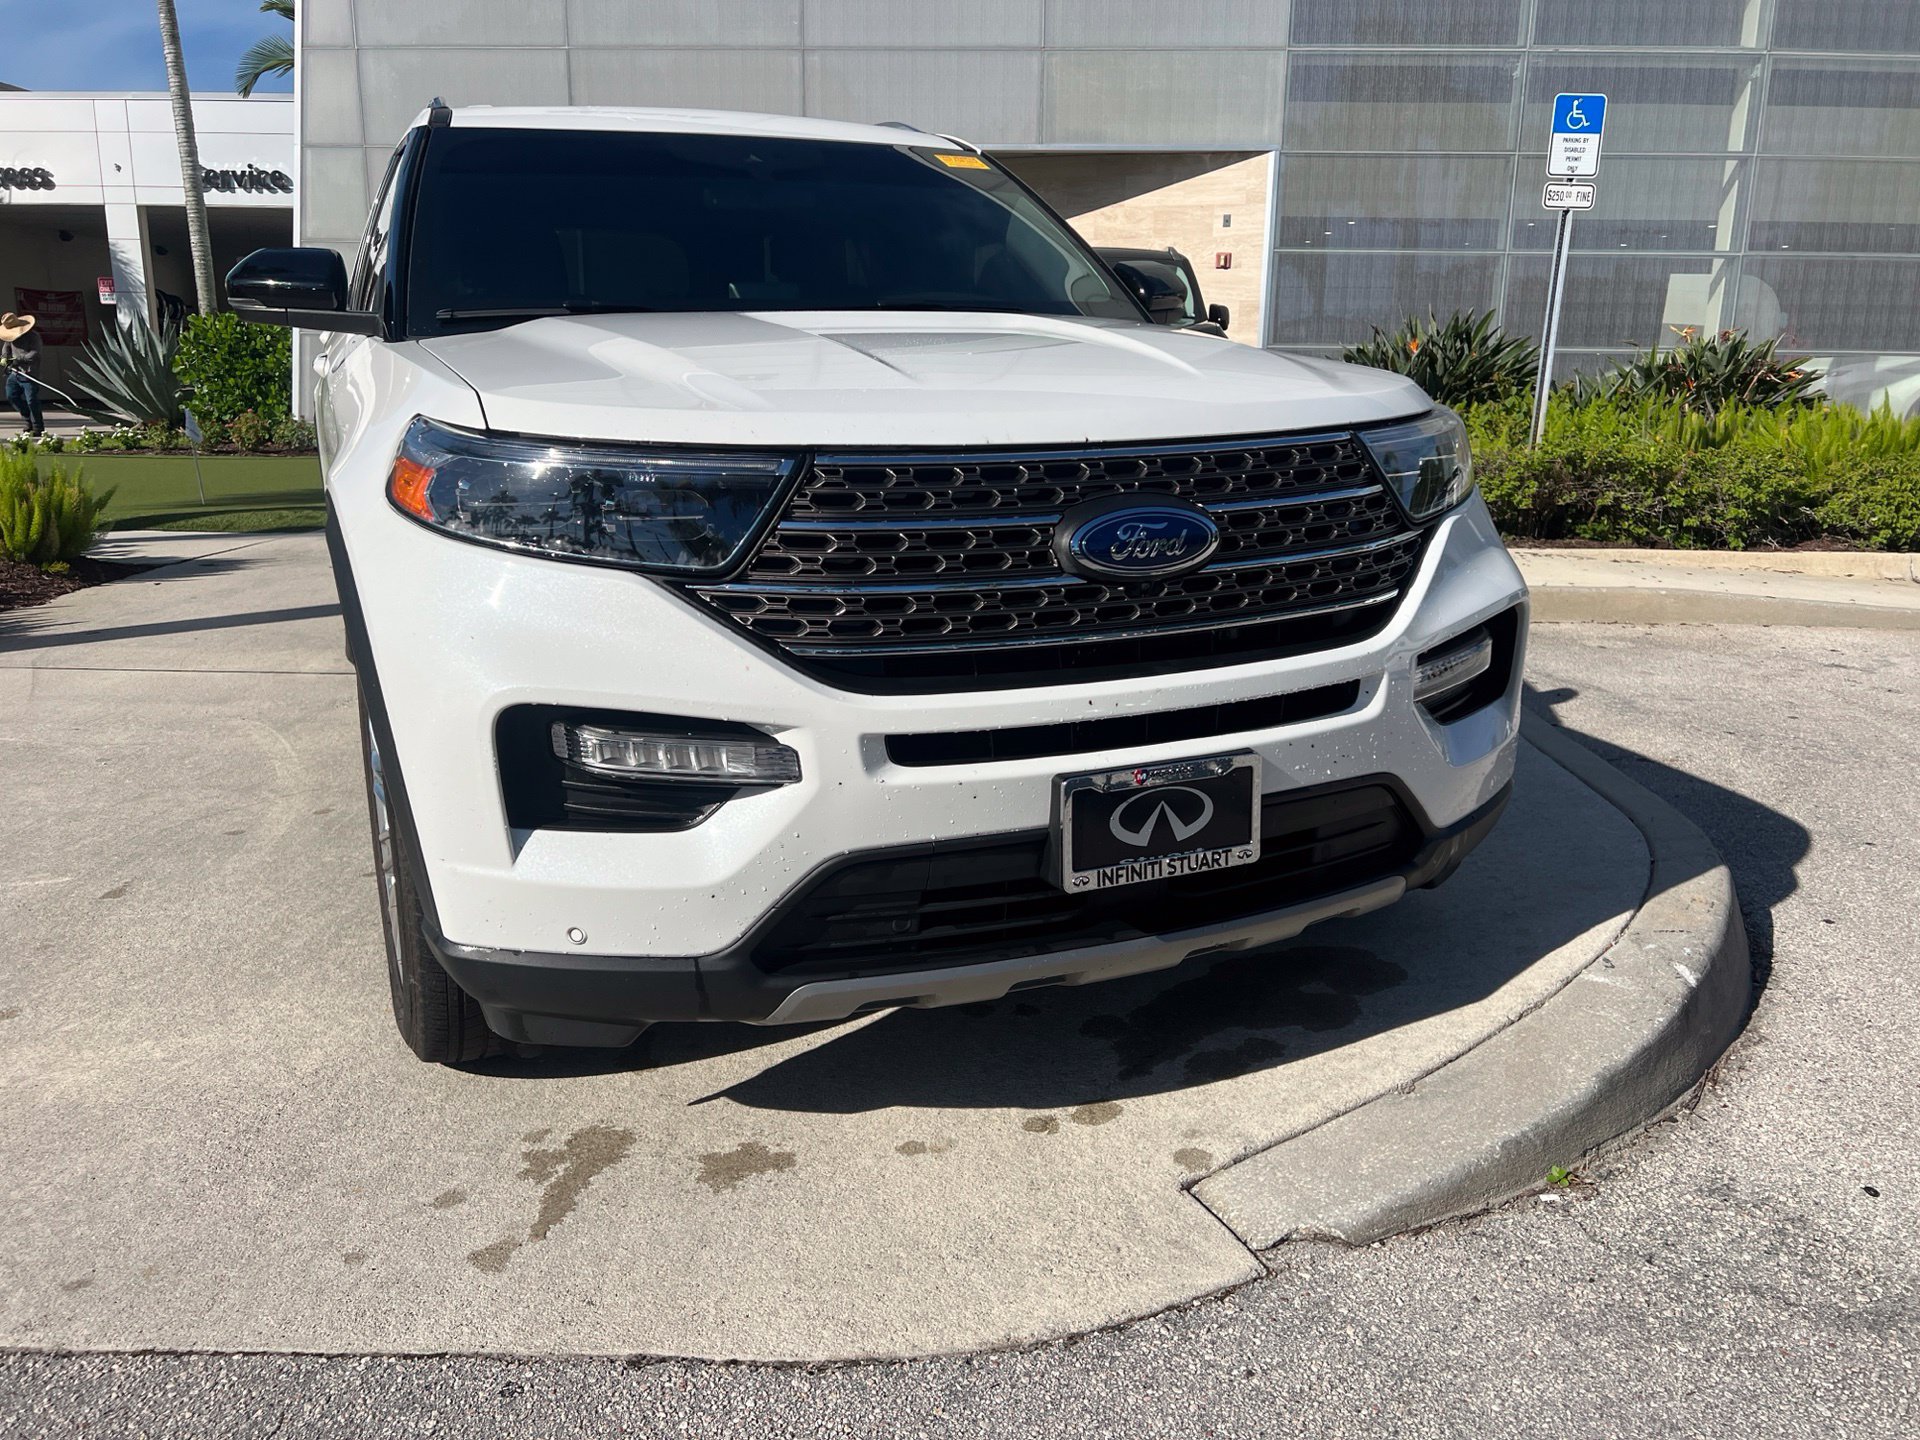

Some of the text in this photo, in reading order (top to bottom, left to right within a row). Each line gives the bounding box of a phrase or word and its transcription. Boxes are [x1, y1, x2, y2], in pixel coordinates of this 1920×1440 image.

[199, 163, 294, 194] ervice
[1575, 191, 1591, 202] FINE
[1110, 521, 1188, 561] Ford
[1096, 860, 1163, 888] INFINITI
[1167, 849, 1233, 876] STUART
